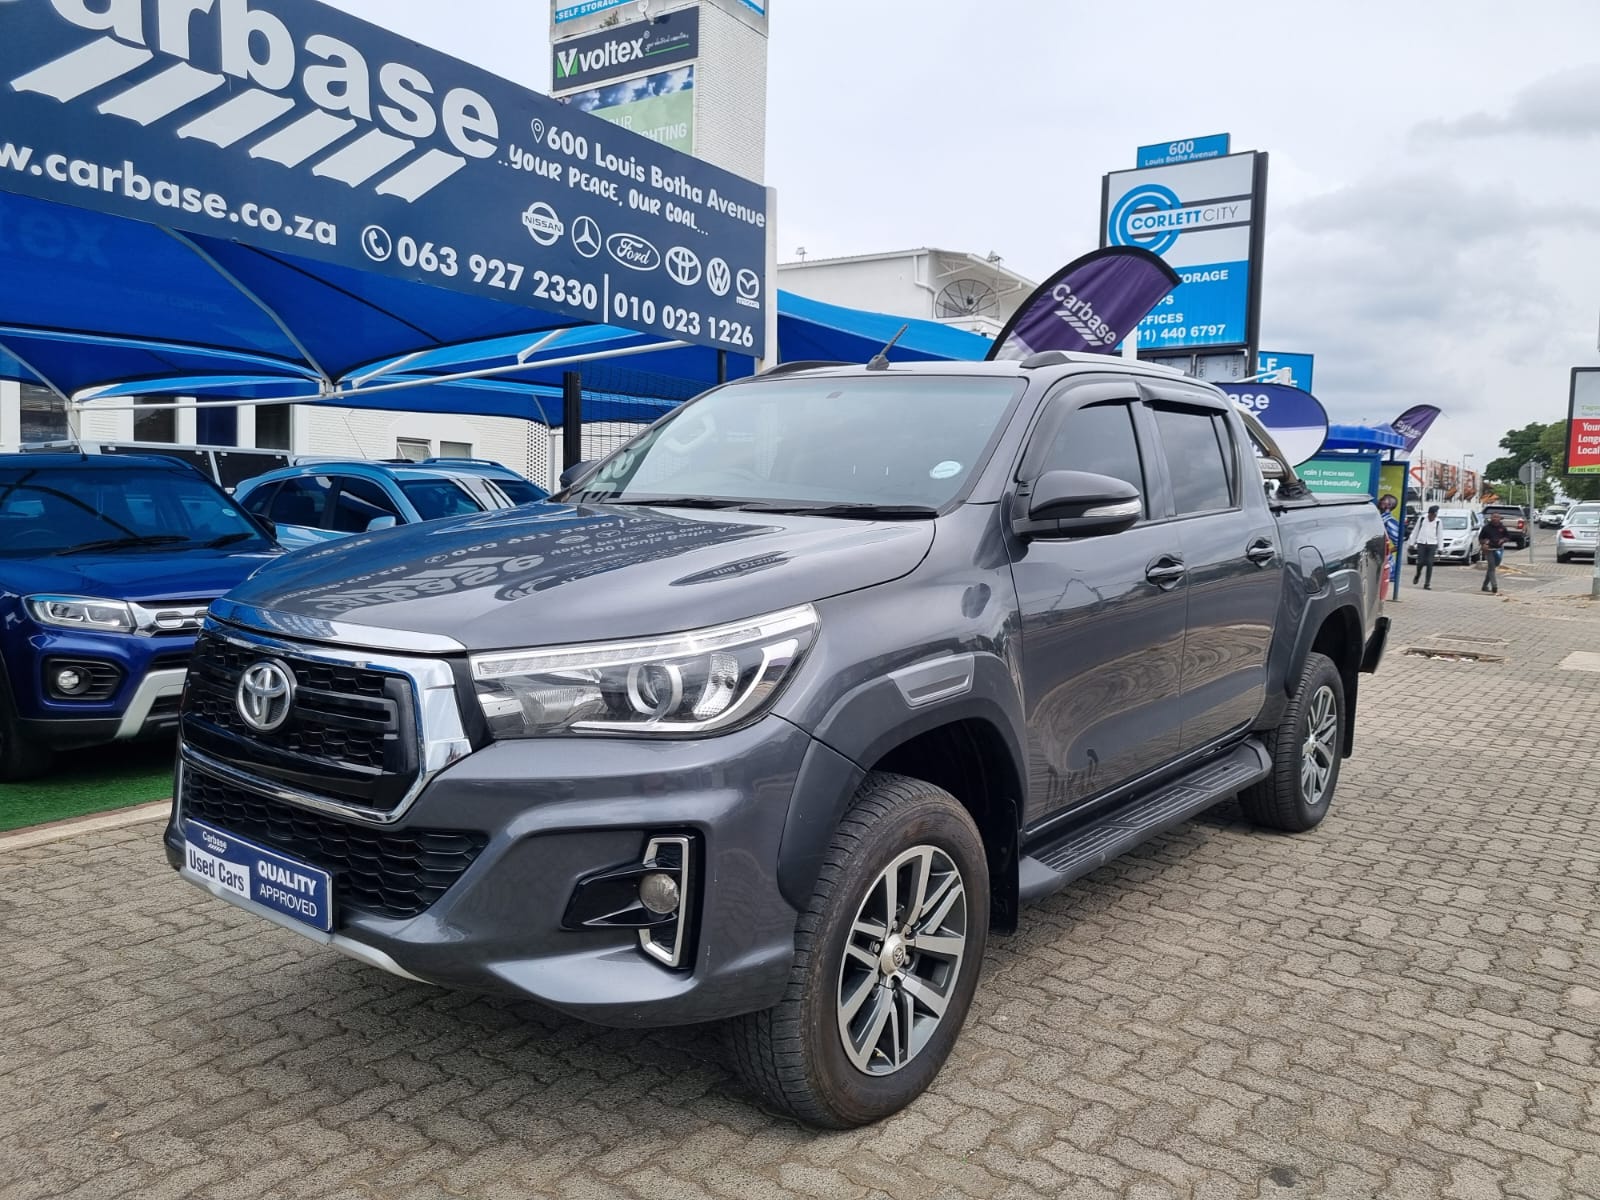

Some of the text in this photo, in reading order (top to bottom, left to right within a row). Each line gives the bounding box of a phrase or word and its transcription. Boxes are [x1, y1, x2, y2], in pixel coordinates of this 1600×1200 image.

[50, 0, 499, 159] arbase
[1145, 149, 1219, 167] Louis Botha Avenue
[1168, 140, 1195, 156] 600
[547, 126, 766, 228] 600 Louis Botha Avenue
[525, 215, 562, 233] NISSAN
[616, 237, 652, 265] Ford
[397, 235, 754, 348] 063 927 2330 010 023 1226
[1052, 283, 1117, 345] Carbase
[1160, 326, 1187, 340] 440
[1190, 324, 1226, 338] 6797
[202, 831, 228, 850] Carbase
[188, 848, 245, 893] Used Cars
[257, 860, 317, 897] QUALITY
[259, 883, 318, 918] APPROVED
